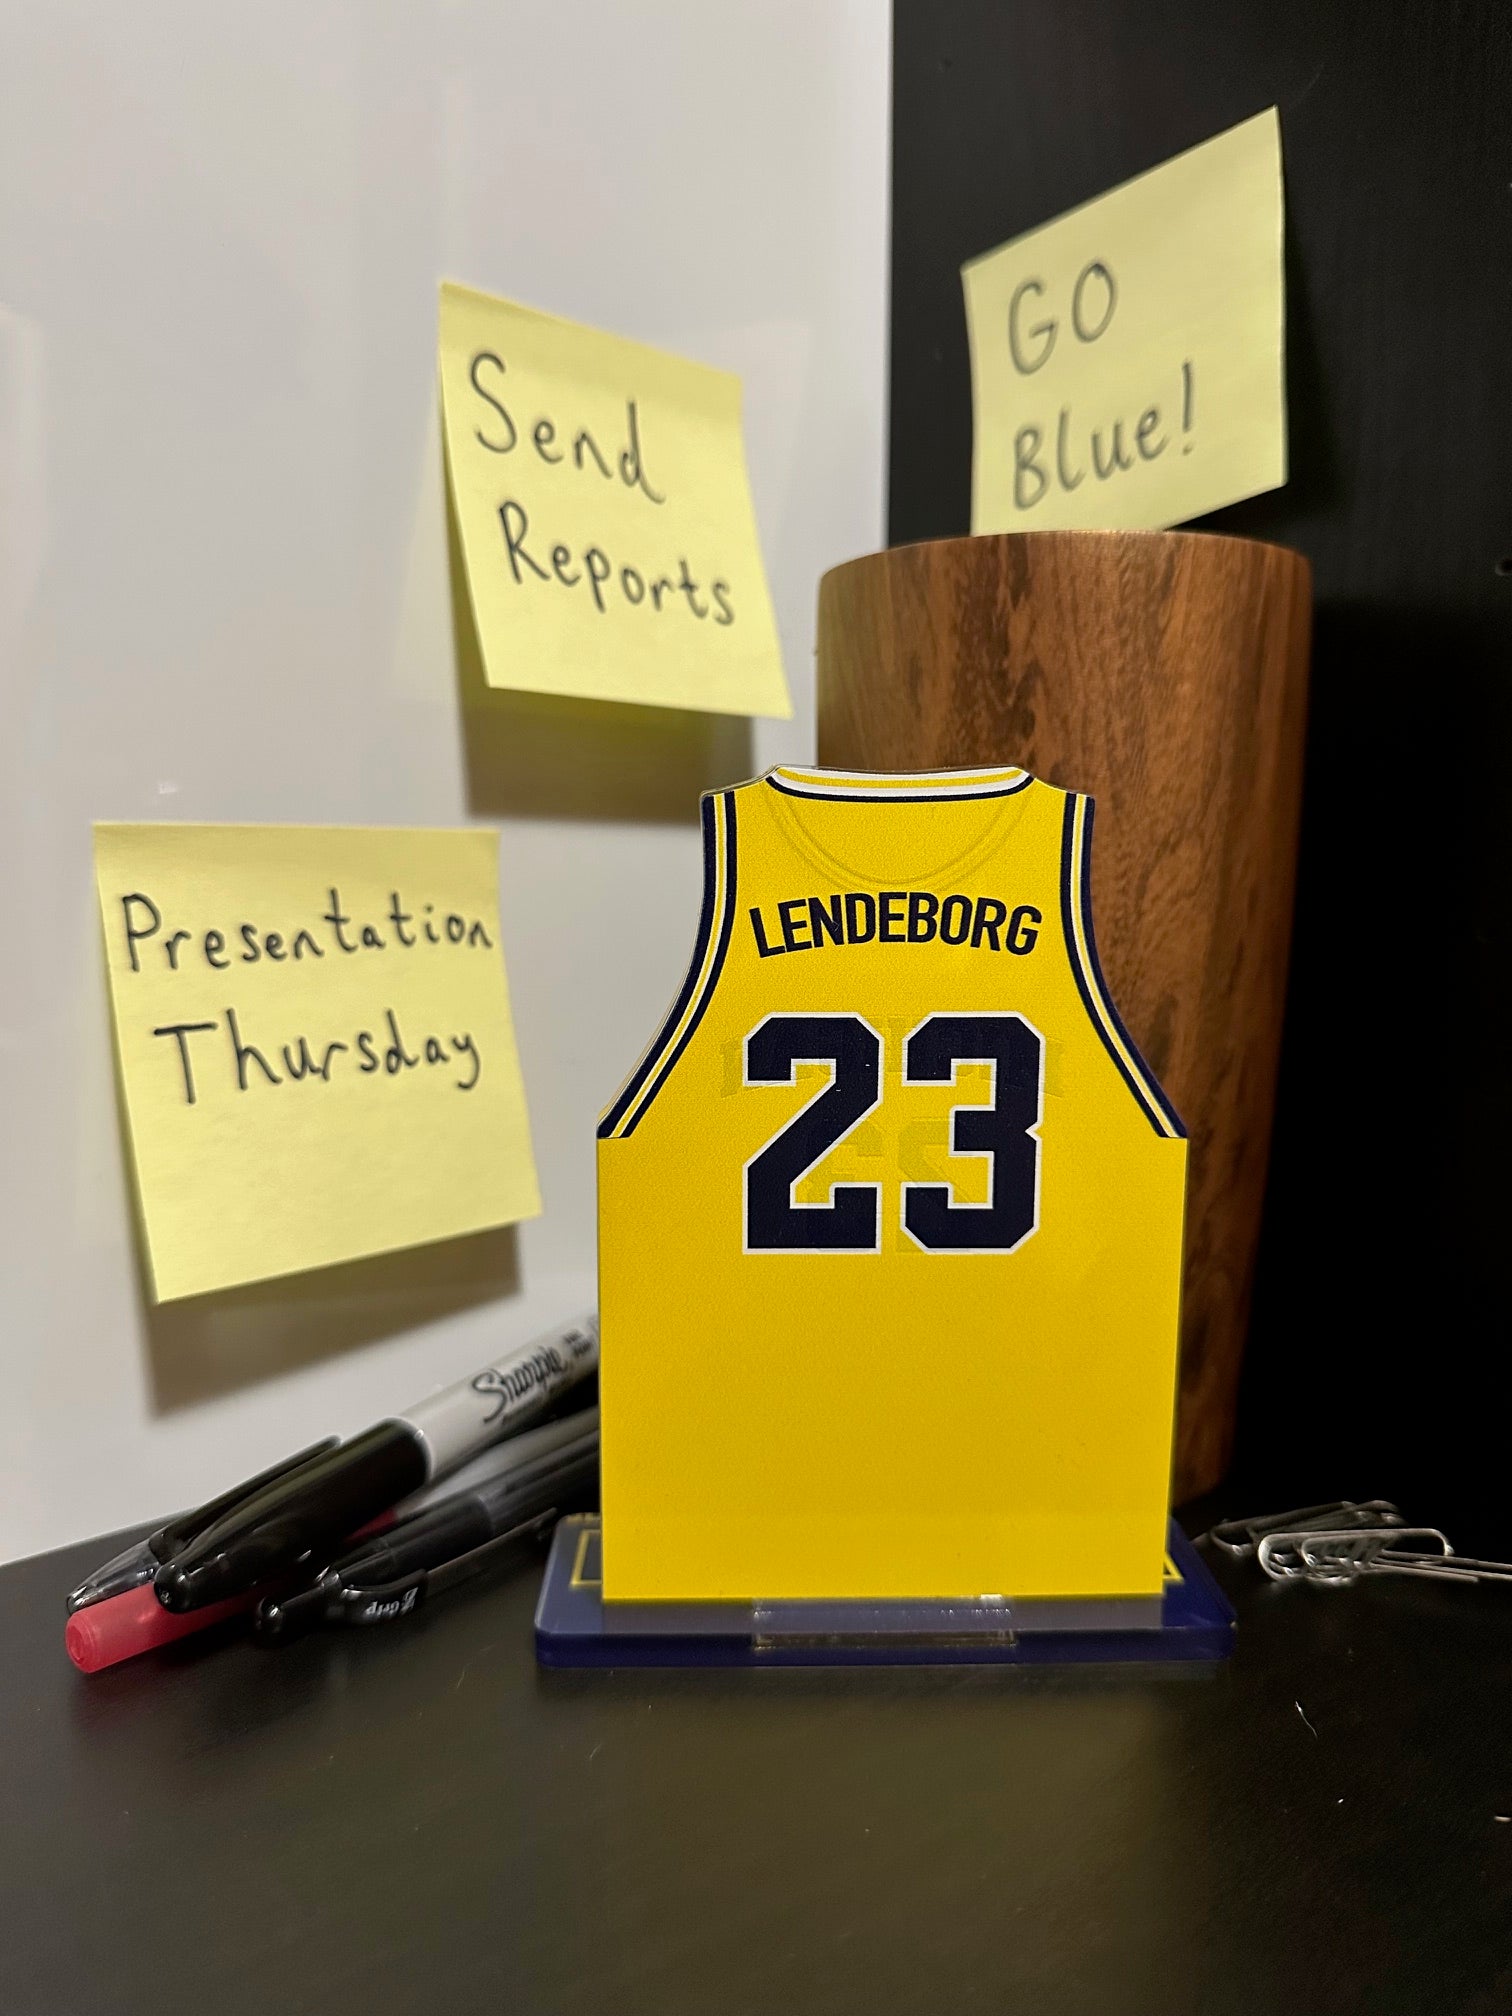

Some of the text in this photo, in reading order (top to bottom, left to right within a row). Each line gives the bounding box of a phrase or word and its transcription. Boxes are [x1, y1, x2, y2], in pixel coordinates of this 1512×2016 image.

[469, 351, 666, 505] Send
[1013, 358, 1196, 511] Blue!
[499, 500, 735, 626] Reports
[120, 887, 493, 972] Presentation
[748, 891, 1043, 959] LENDEBORG
[153, 1008, 482, 1104] Thursday
[742, 1011, 1046, 1255] 23
